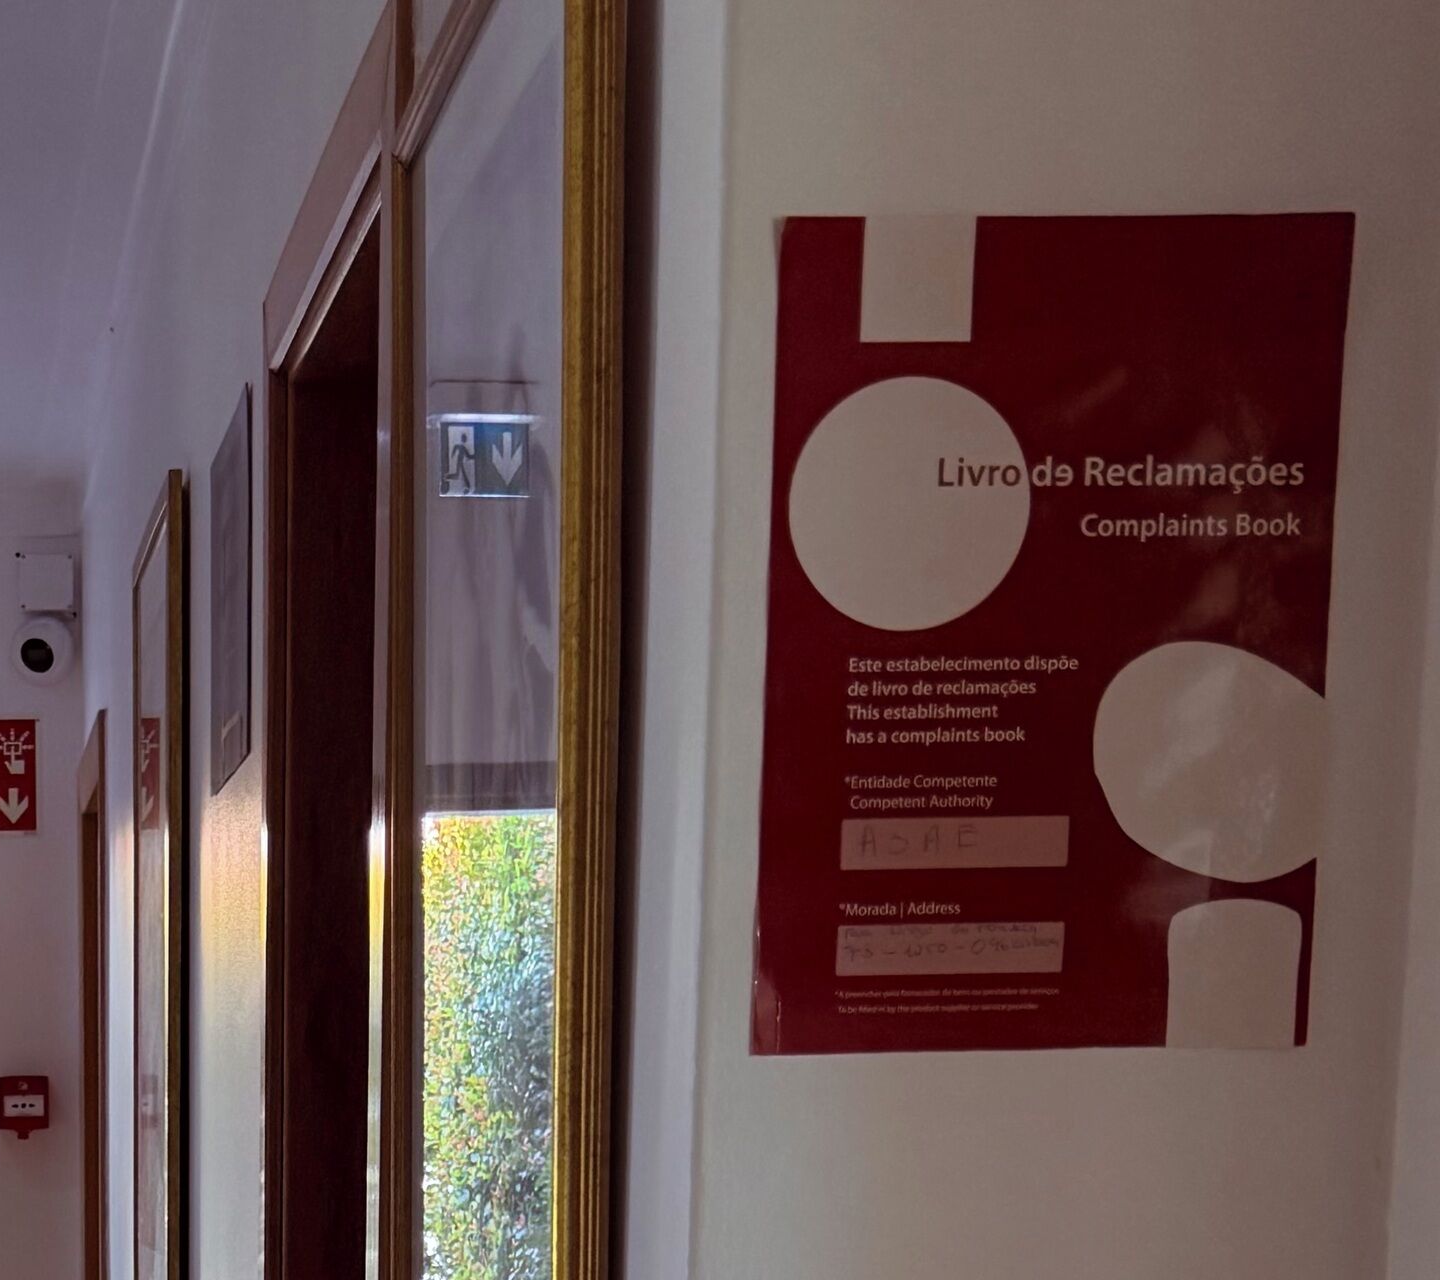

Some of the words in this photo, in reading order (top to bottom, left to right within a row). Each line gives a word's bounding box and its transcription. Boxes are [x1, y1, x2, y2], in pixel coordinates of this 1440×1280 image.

[938, 457, 1021, 487] Livro
[1032, 456, 1074, 487] de
[1084, 454, 1304, 494] Reclamações
[1080, 512, 1228, 542] Complaints
[1235, 512, 1301, 536] Book
[849, 657, 883, 673] Este
[886, 656, 1021, 672] estabelecimento
[1024, 656, 1079, 674] dispõe
[848, 681, 869, 697] de
[872, 680, 909, 696] livro
[912, 680, 933, 695] de
[936, 680, 1037, 698] reclamações
[847, 705, 880, 720] This
[883, 703, 999, 719] establishment
[846, 728, 874, 744] has
[877, 731, 887, 743] a
[891, 728, 980, 746] complaints
[984, 726, 1026, 742] book
[914, 775, 998, 790] Competente
[850, 795, 926, 811] Competent
[930, 793, 994, 809] Authority
[907, 902, 961, 916] Address
